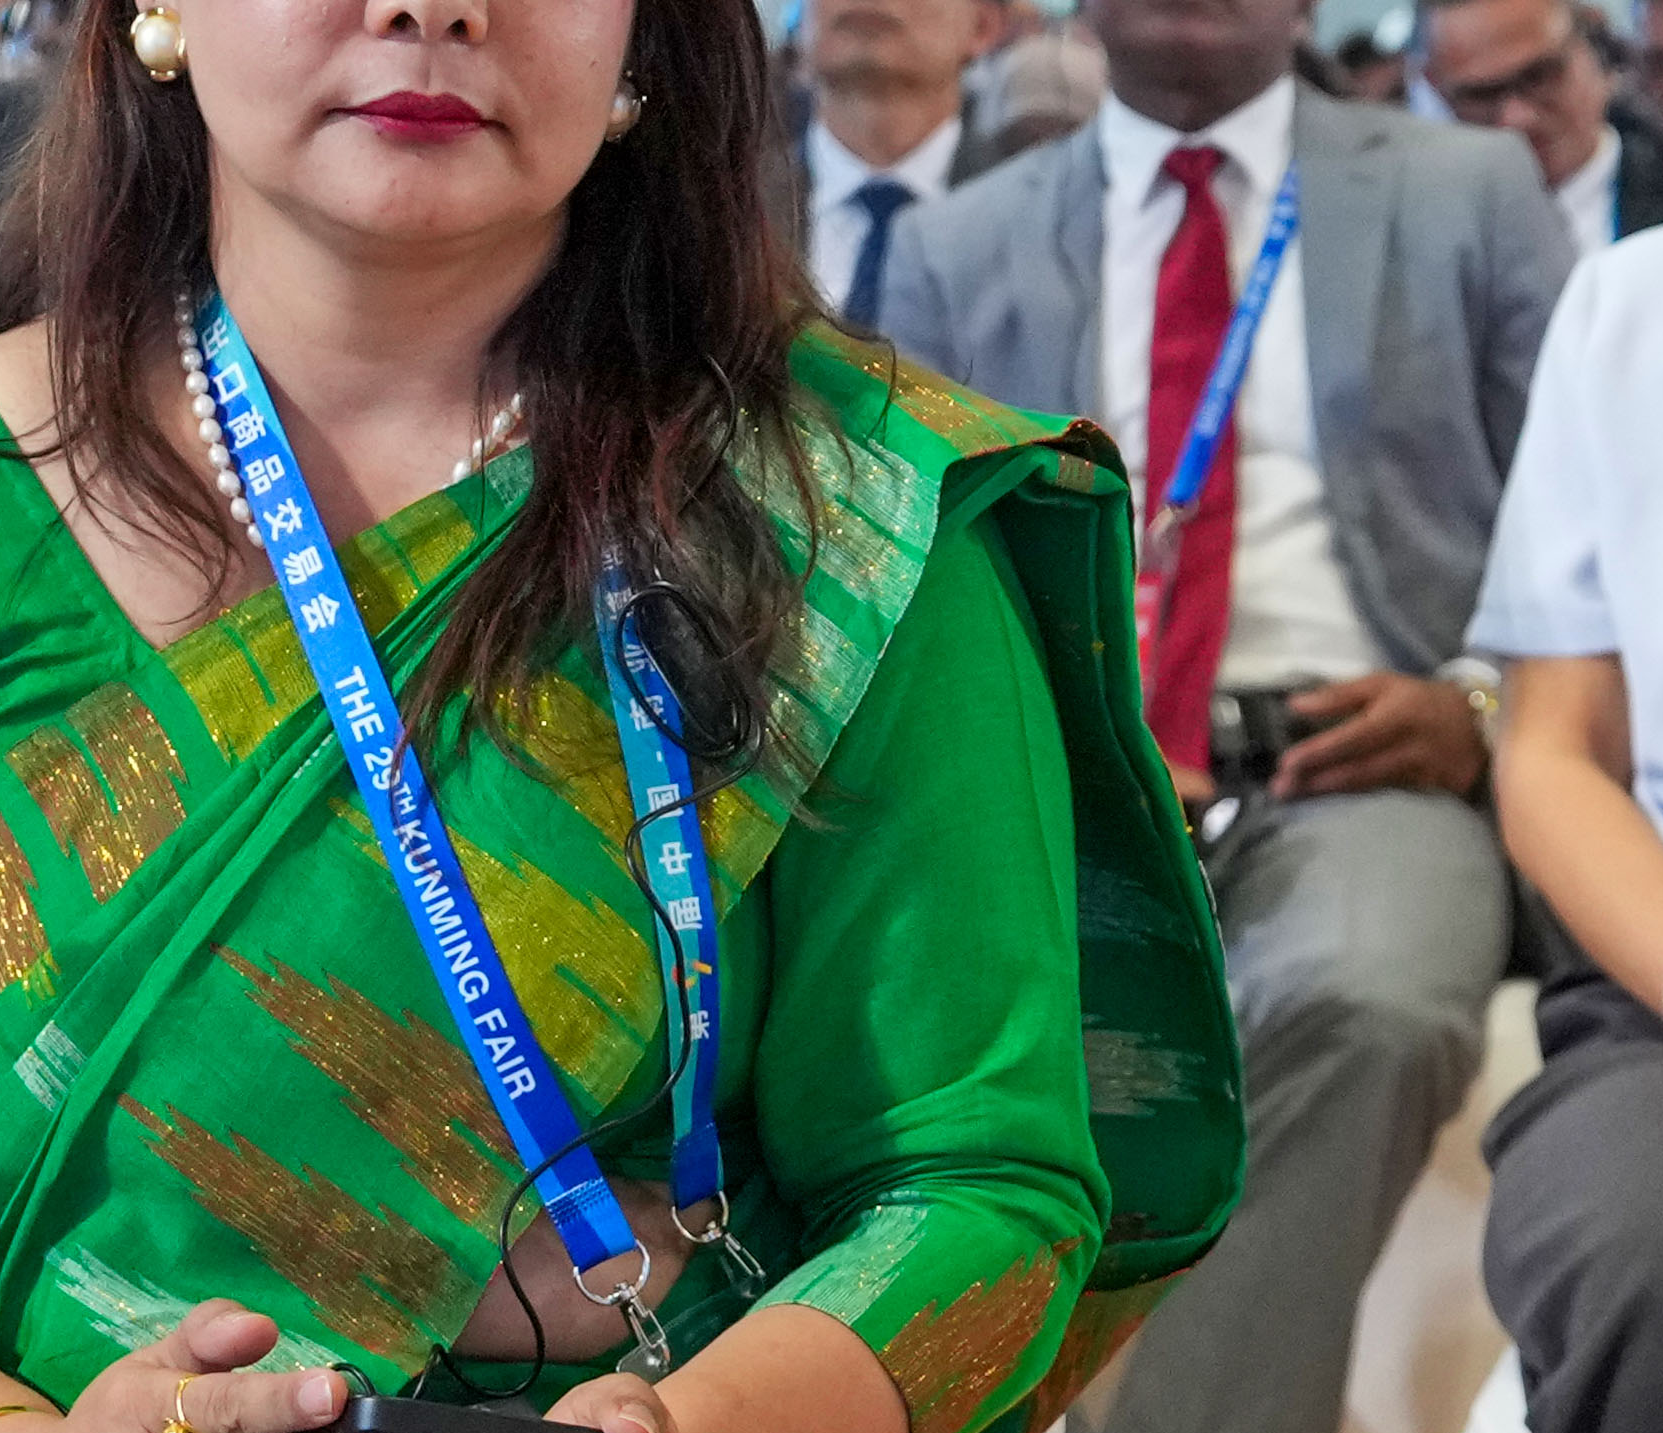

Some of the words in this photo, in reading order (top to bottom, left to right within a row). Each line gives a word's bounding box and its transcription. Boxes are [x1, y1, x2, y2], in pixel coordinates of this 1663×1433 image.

[335, 665, 385, 742] THE
[363, 746, 416, 817] 29TH
[393, 819, 490, 1004] KUNMING
[474, 1007, 536, 1101] FAIR
